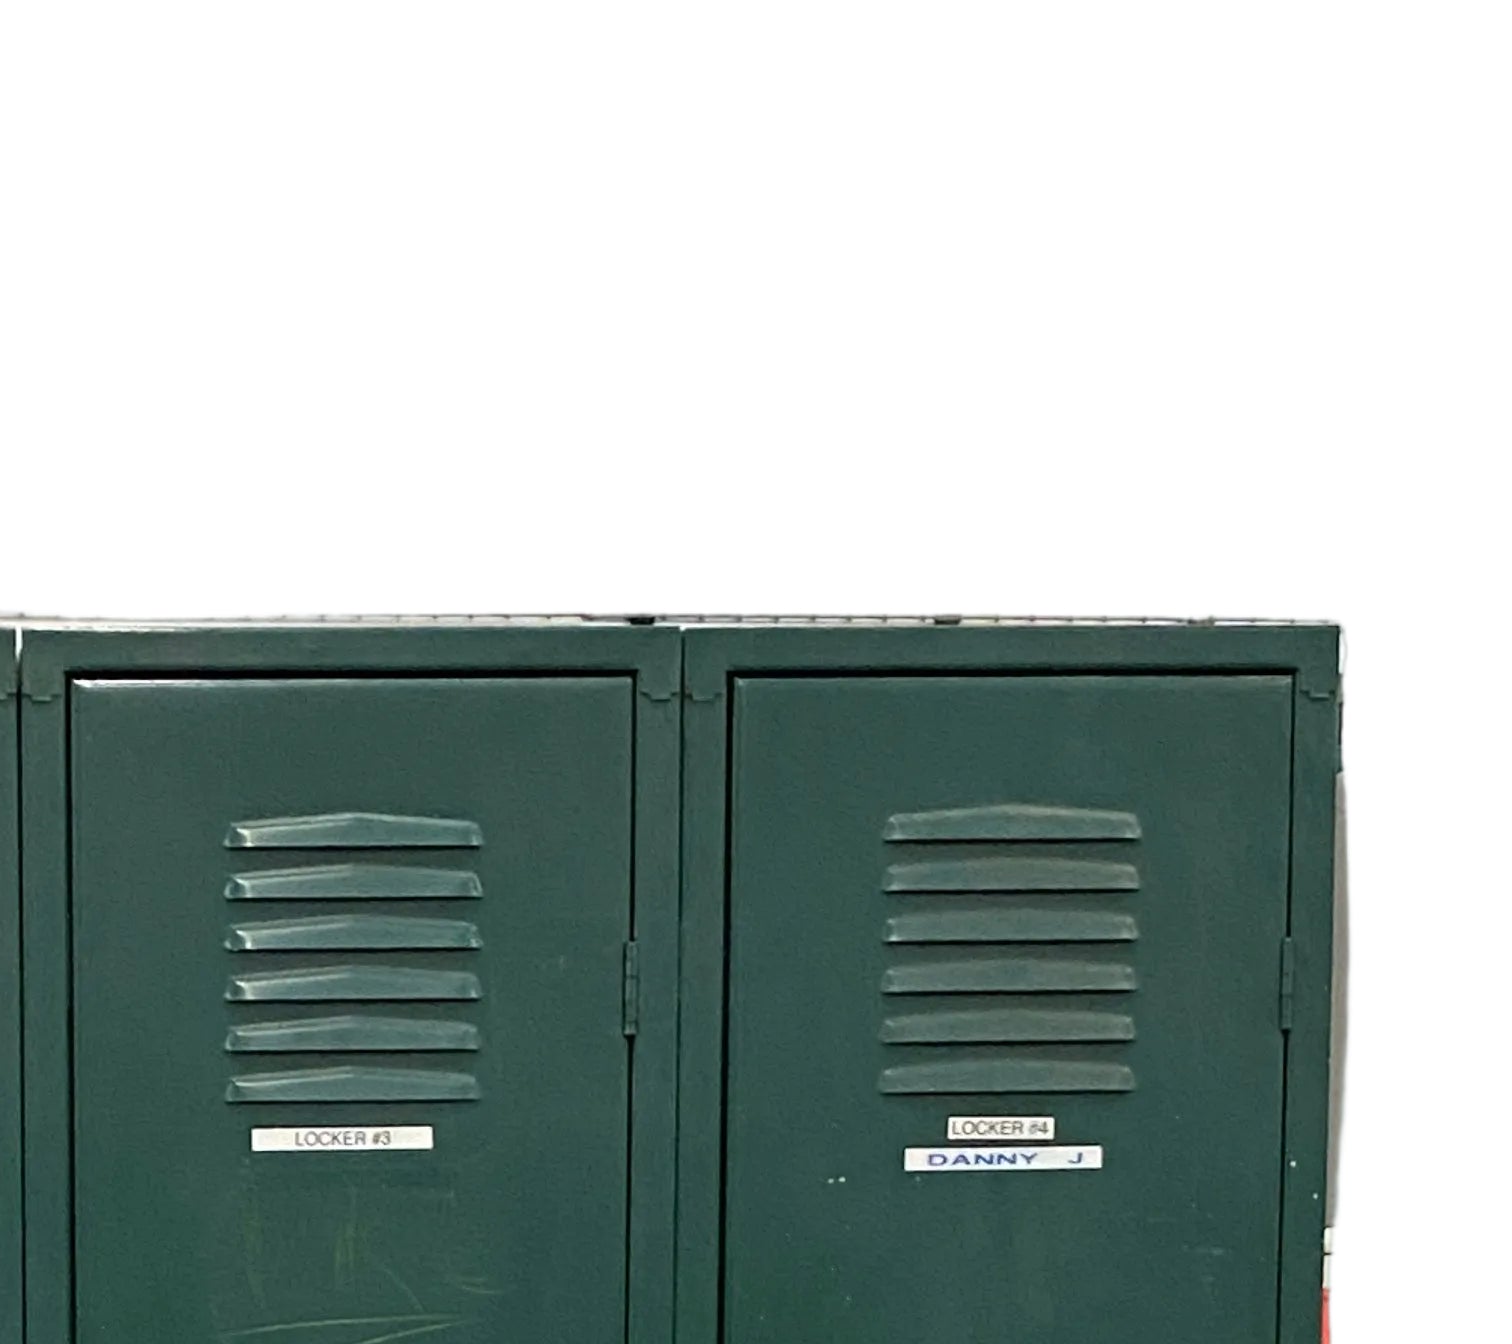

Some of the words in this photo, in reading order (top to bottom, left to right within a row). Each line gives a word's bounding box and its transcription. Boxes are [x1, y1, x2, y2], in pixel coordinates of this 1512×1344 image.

[951, 1120, 1024, 1136] LOCKER
[294, 1130, 367, 1147] LOCKER
[372, 1130, 392, 1146] #3
[926, 1152, 1038, 1167] DANNY
[1067, 1152, 1084, 1165] J
